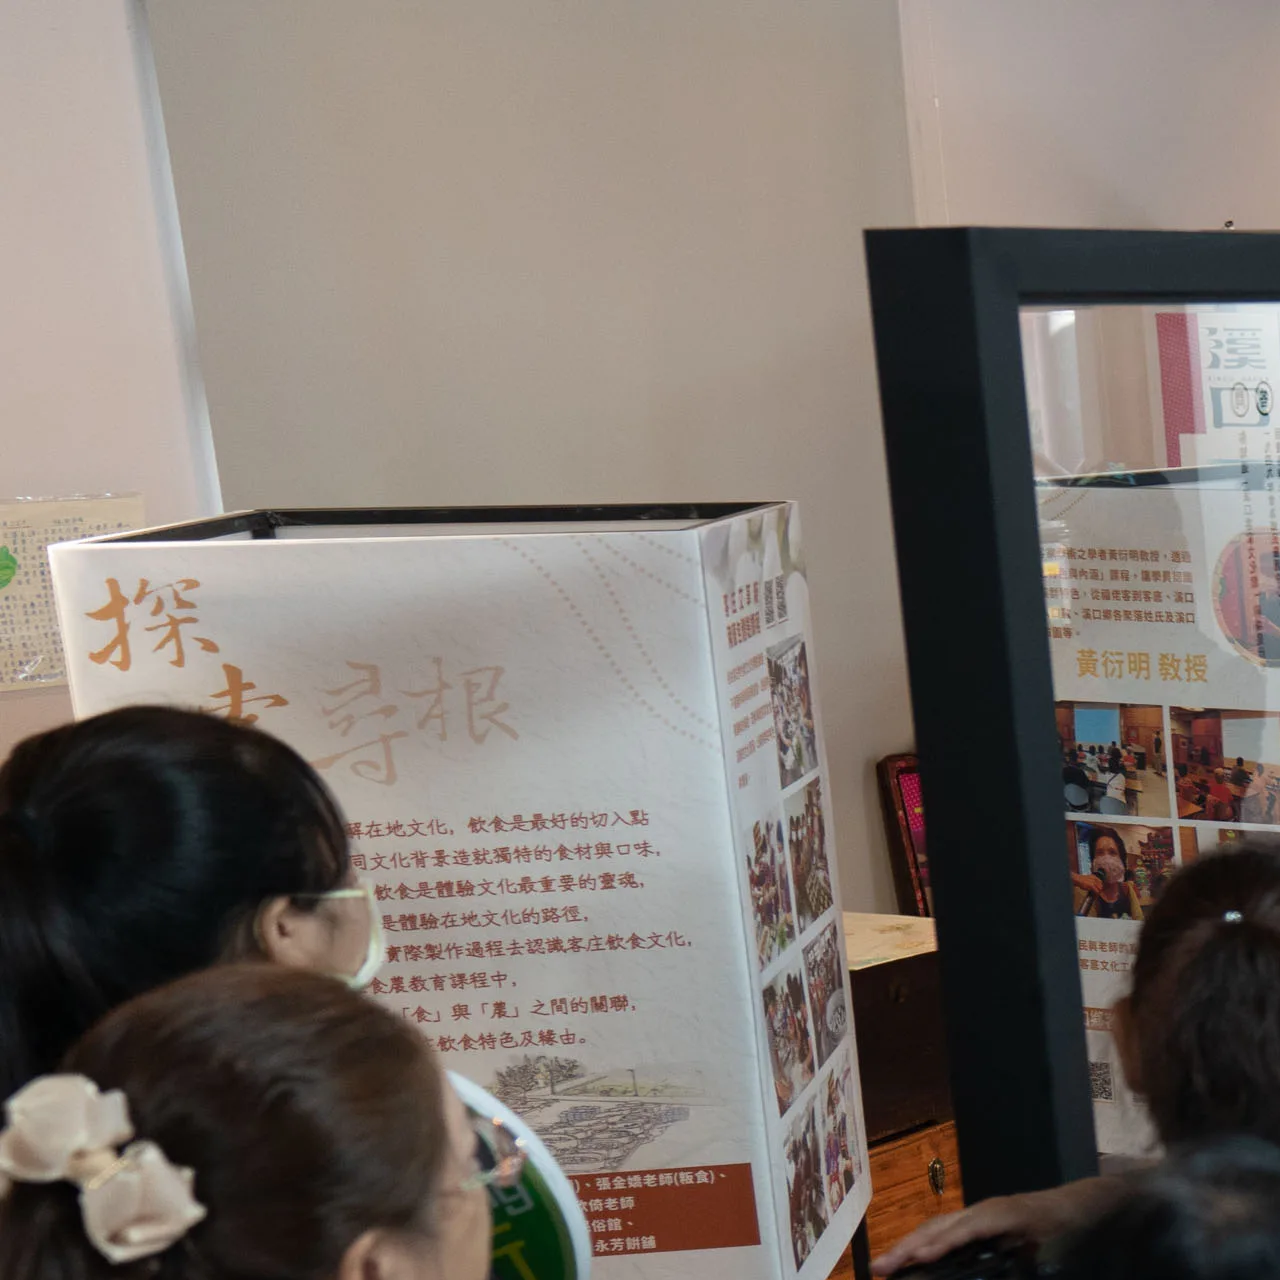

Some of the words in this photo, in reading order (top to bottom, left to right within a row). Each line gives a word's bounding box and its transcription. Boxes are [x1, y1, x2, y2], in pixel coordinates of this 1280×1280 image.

[1076, 649, 1151, 680] 黃衍明
[1158, 652, 1208, 683] 教授
